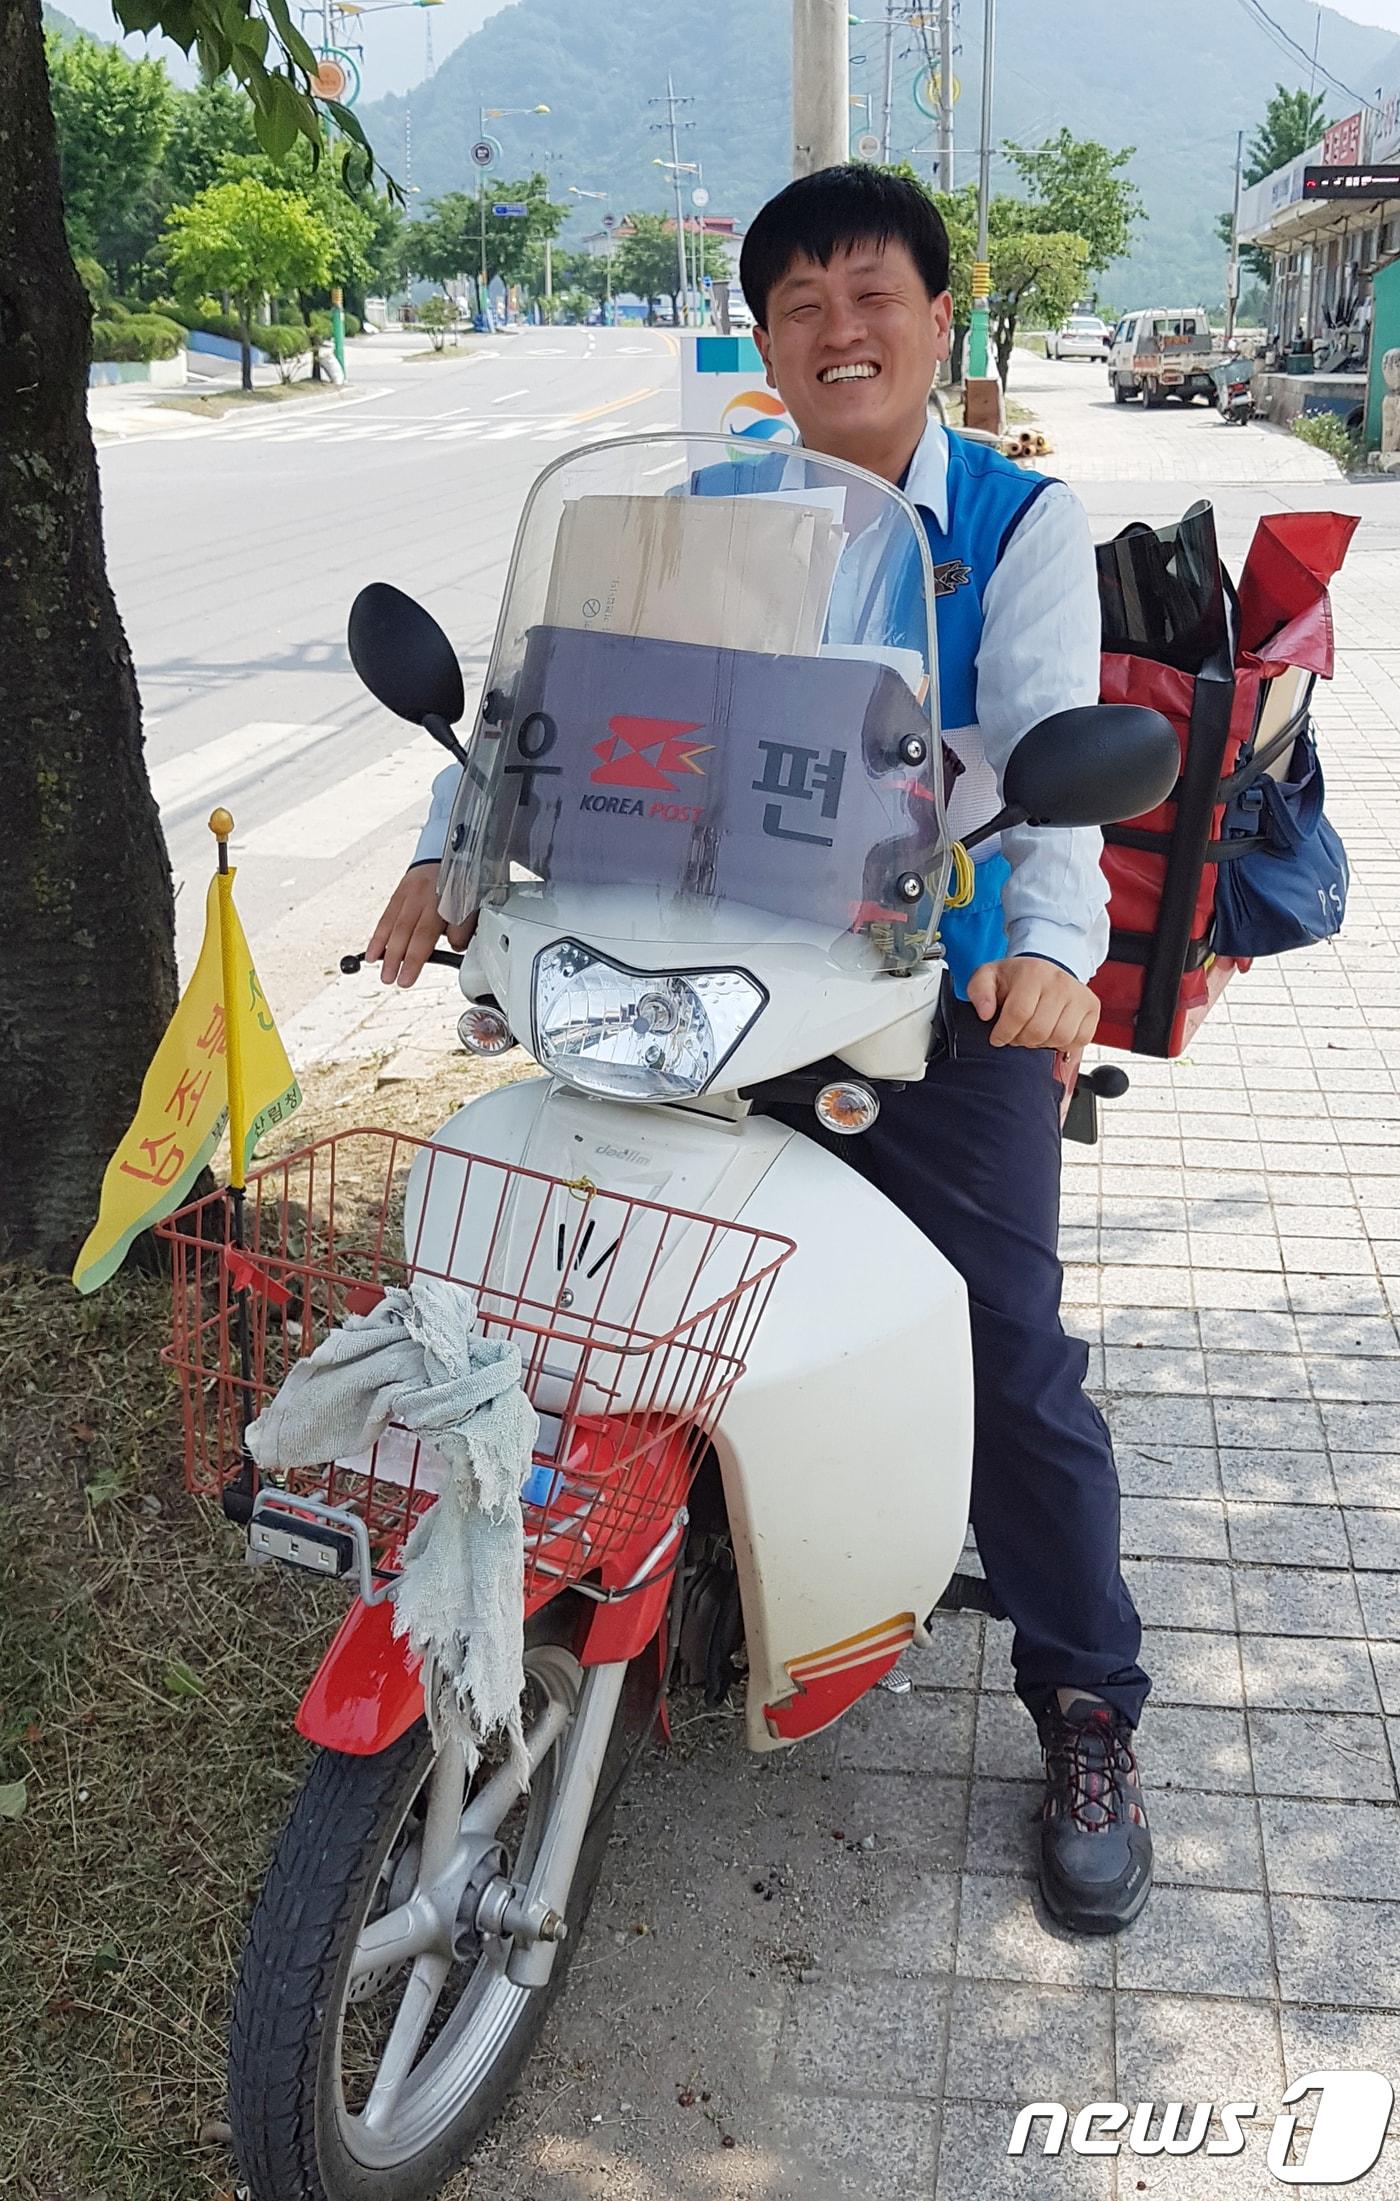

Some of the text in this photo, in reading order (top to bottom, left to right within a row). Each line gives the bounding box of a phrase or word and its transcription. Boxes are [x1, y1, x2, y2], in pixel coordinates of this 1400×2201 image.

[579, 794, 704, 824] KOREA POST
[751, 739, 848, 848] 편
[254, 1087, 298, 1138] 산림청
